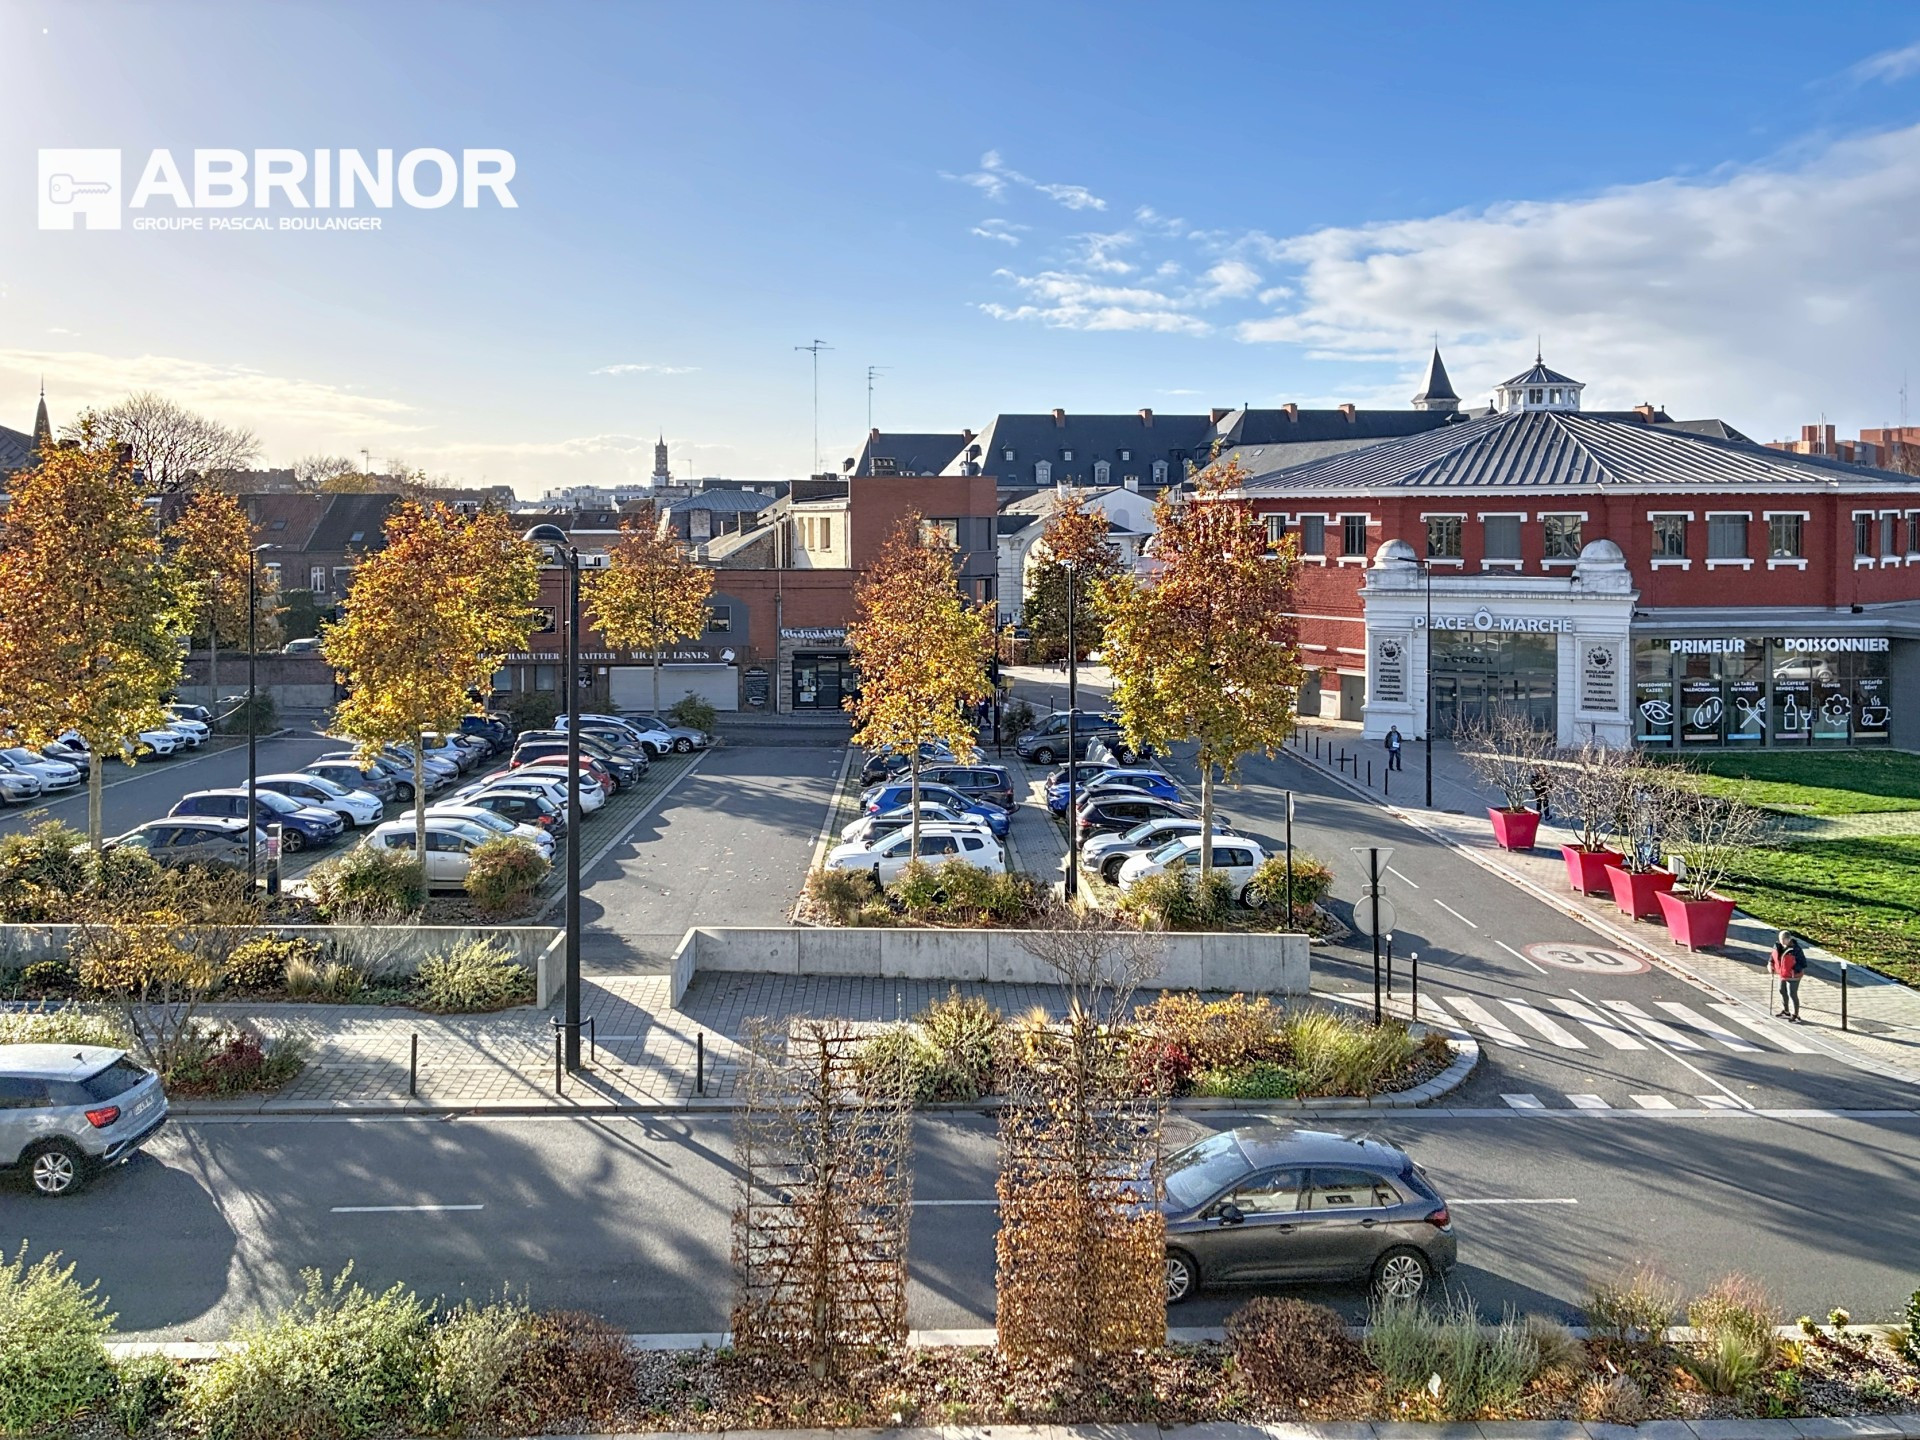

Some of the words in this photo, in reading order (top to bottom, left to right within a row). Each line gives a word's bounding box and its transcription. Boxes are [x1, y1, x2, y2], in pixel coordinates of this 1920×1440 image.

[1670, 639, 1746, 654] PRIMEUR
[1784, 638, 1890, 653] POISSONNIER
[503, 652, 560, 660] HARCUTIER
[577, 652, 616, 660] RAITEUR
[630, 651, 669, 660] MICEL
[673, 651, 710, 660] LESNES
[1547, 949, 1624, 966] 30
